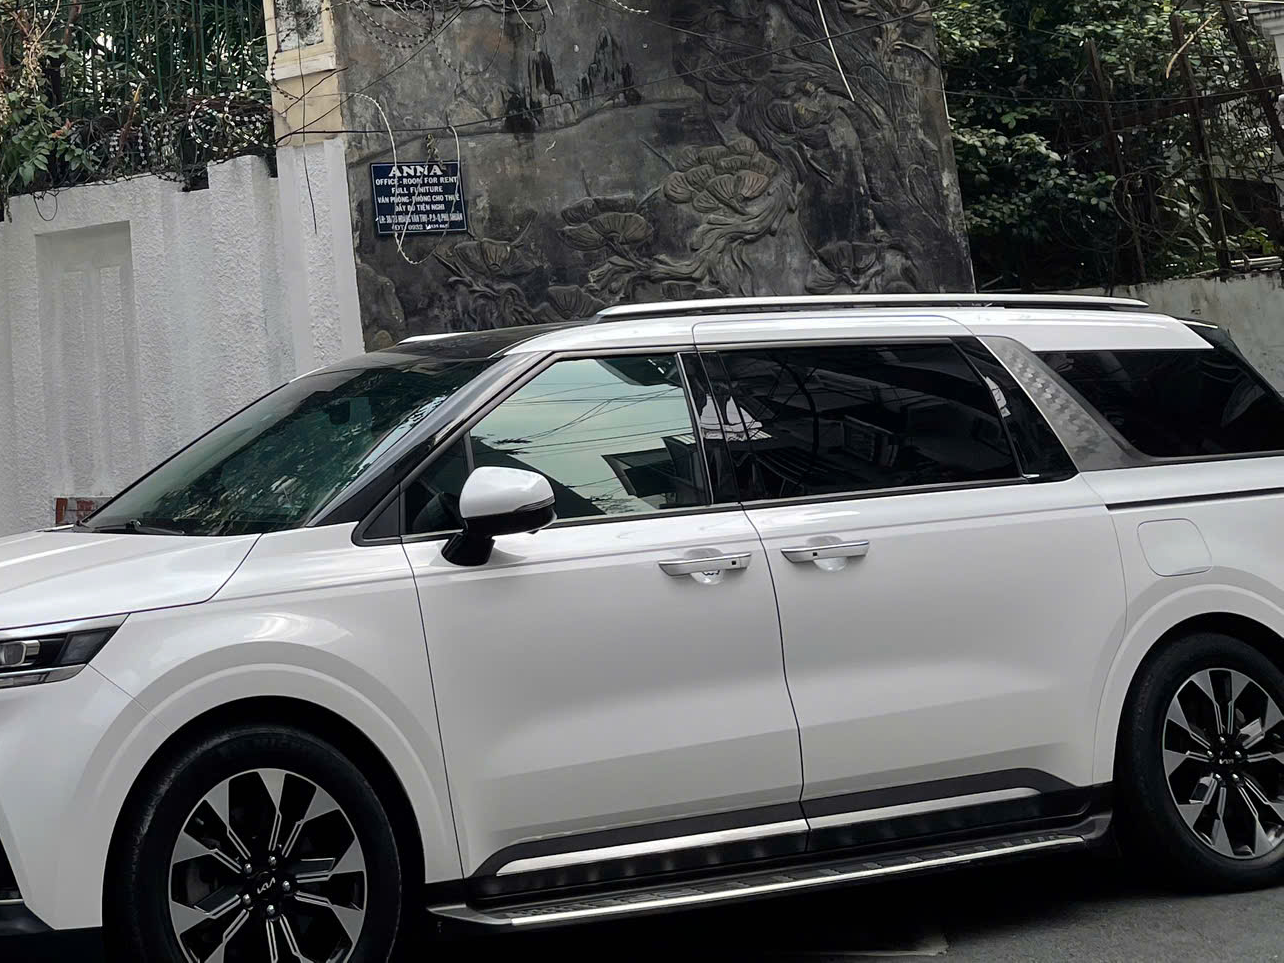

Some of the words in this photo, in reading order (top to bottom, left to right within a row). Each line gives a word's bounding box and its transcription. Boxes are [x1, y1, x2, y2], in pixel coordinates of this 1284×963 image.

[388, 165, 443, 177] ANNA
[376, 178, 398, 186] OFFICE
[403, 177, 423, 185] ROOM
[440, 176, 458, 184] RENT
[391, 186, 408, 194] FULL
[410, 186, 443, 194] FUNITURE
[432, 194, 444, 202] CHO
[431, 203, 445, 211] NGHI
